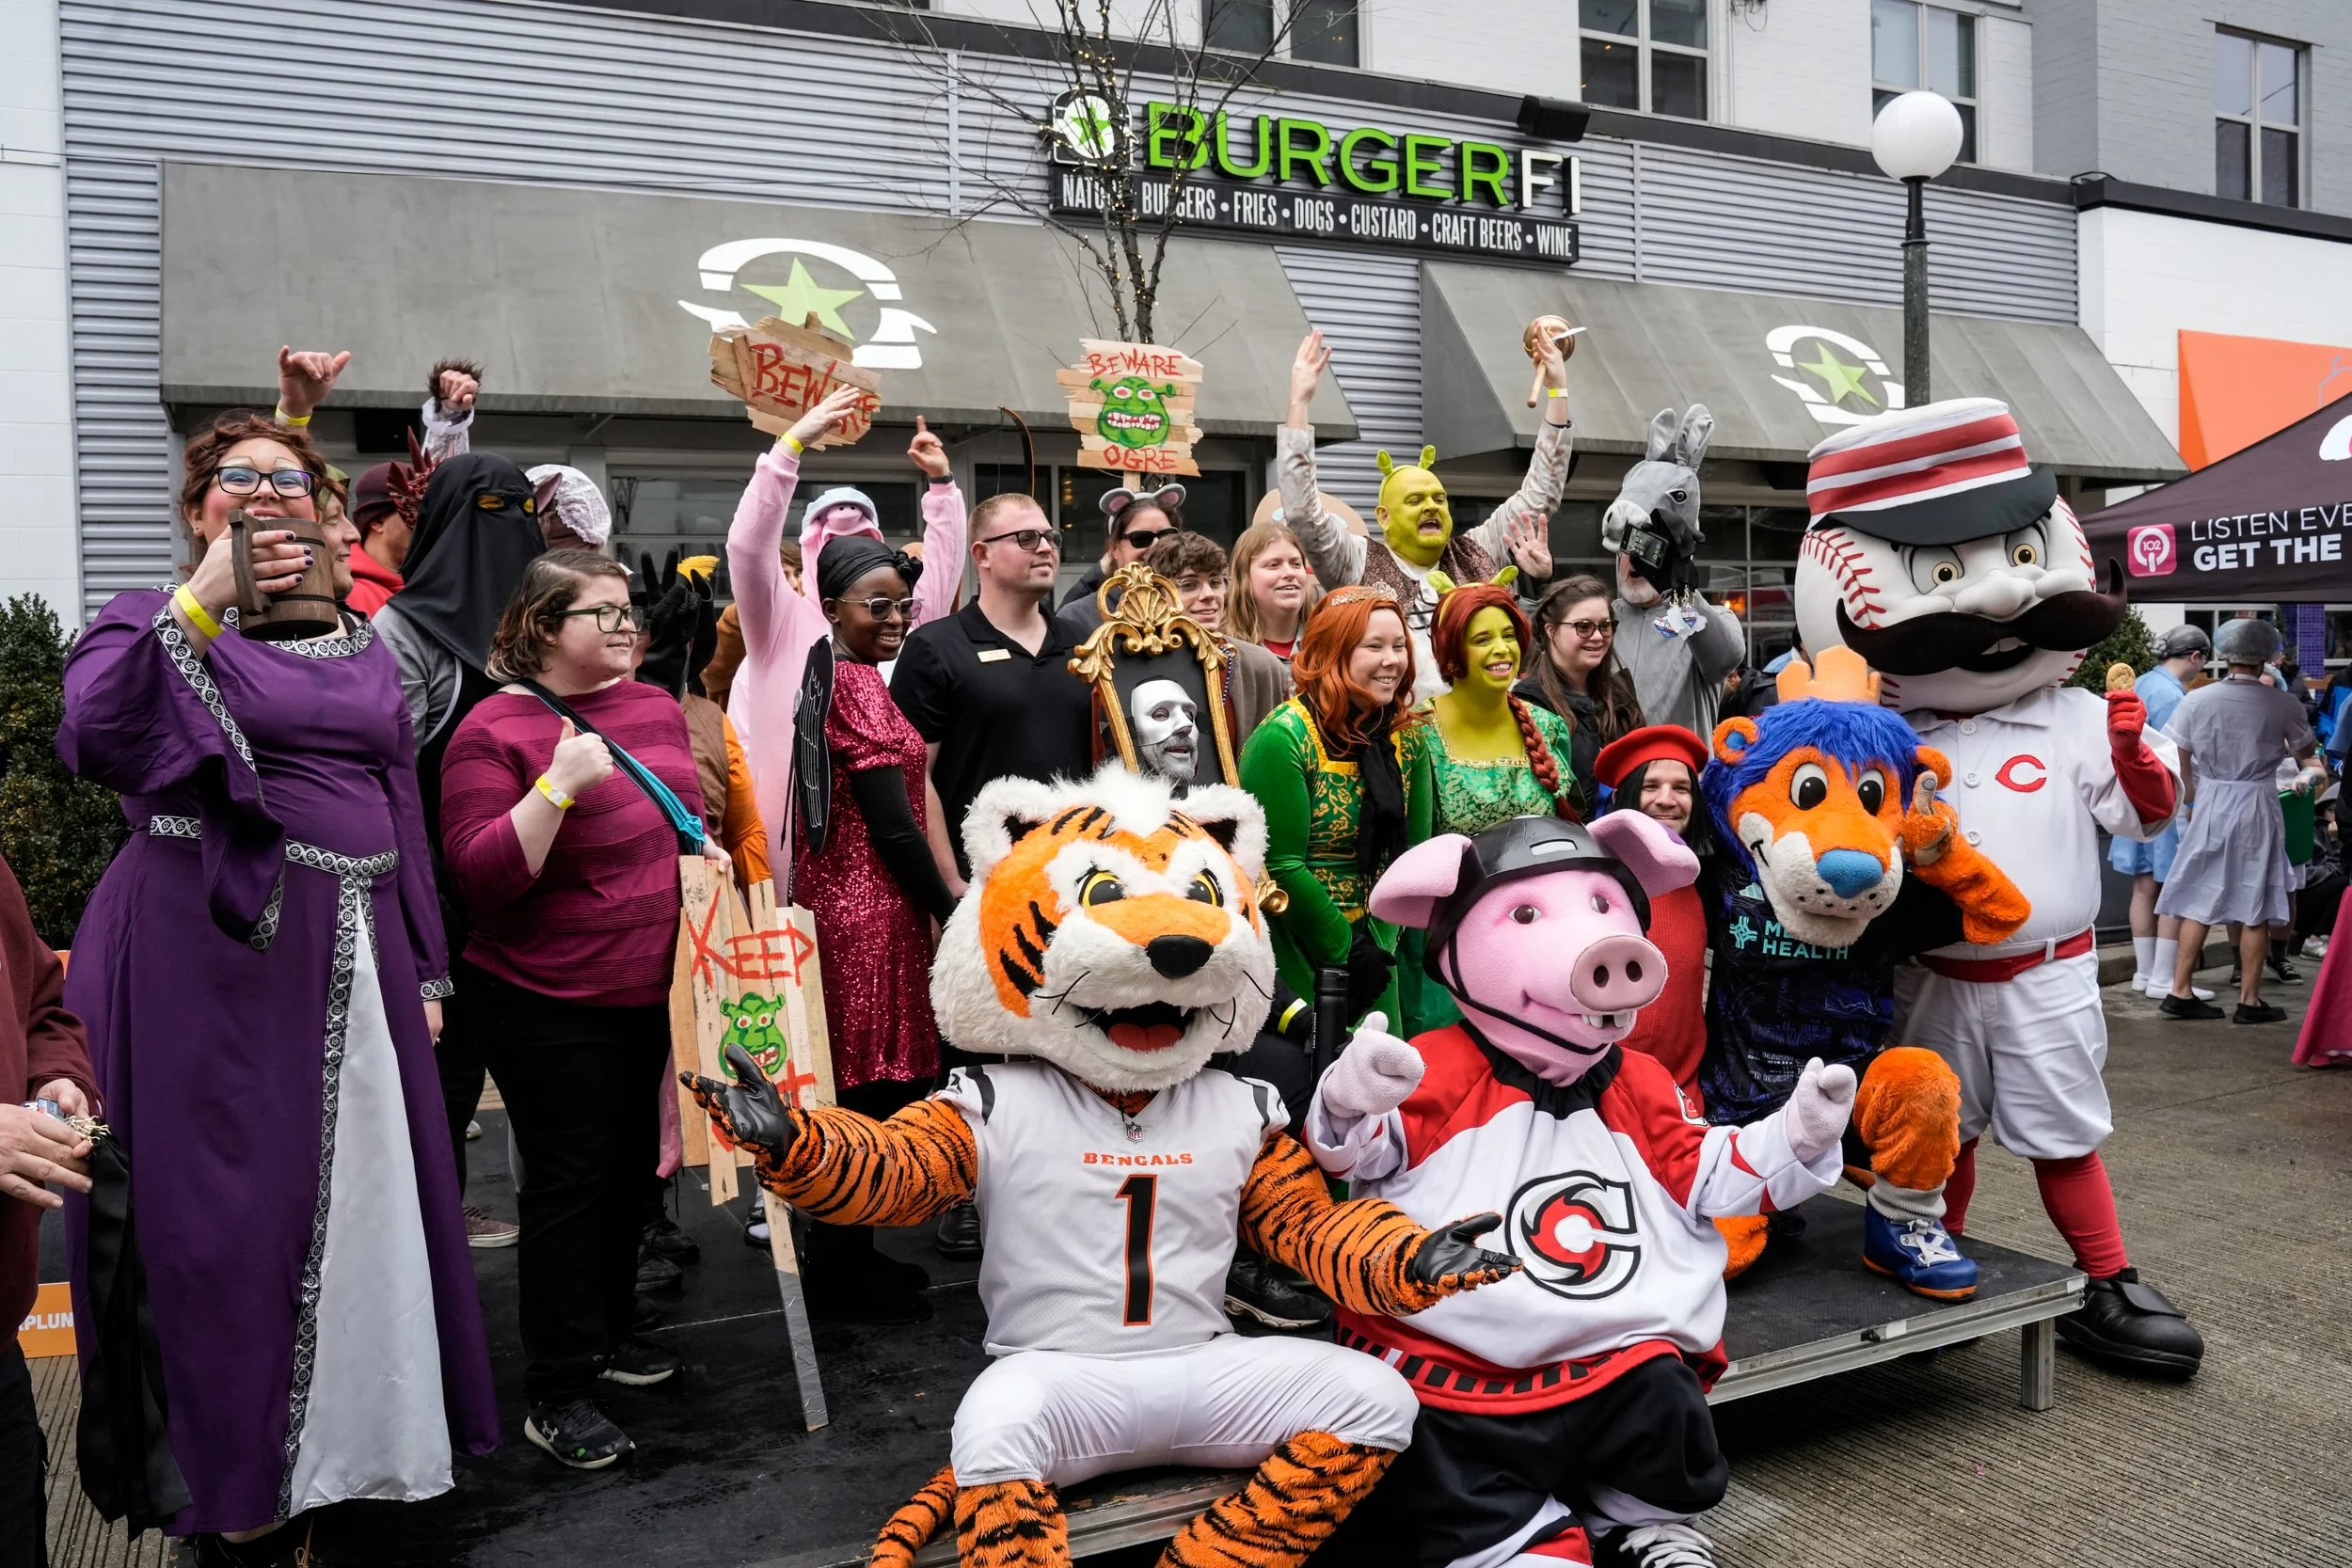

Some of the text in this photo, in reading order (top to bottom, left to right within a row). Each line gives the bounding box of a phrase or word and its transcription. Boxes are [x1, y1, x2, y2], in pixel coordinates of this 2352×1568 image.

[1145, 100, 1581, 214] BURGERFI
[1233, 191, 1278, 227] FRIES
[1295, 197, 1335, 232] DOGS
[1350, 203, 1417, 241] CUSTARD
[1432, 213, 1475, 247] CRAFT
[1479, 218, 1522, 252] BEERS
[1536, 224, 1572, 258] WINE
[1087, 348, 1184, 378] BEWARE
[1104, 444, 1178, 471] OGRE
[2191, 510, 2288, 542] LISTEN
[2142, 540, 2162, 551] 102
[2193, 533, 2342, 572] GET THE
[1994, 754, 2047, 793] C
[686, 882, 815, 992] KEEP
[1762, 939, 1849, 960] HEALTH
[1083, 1151, 1193, 1166] BENGALS
[1115, 1173, 1157, 1326] 1
